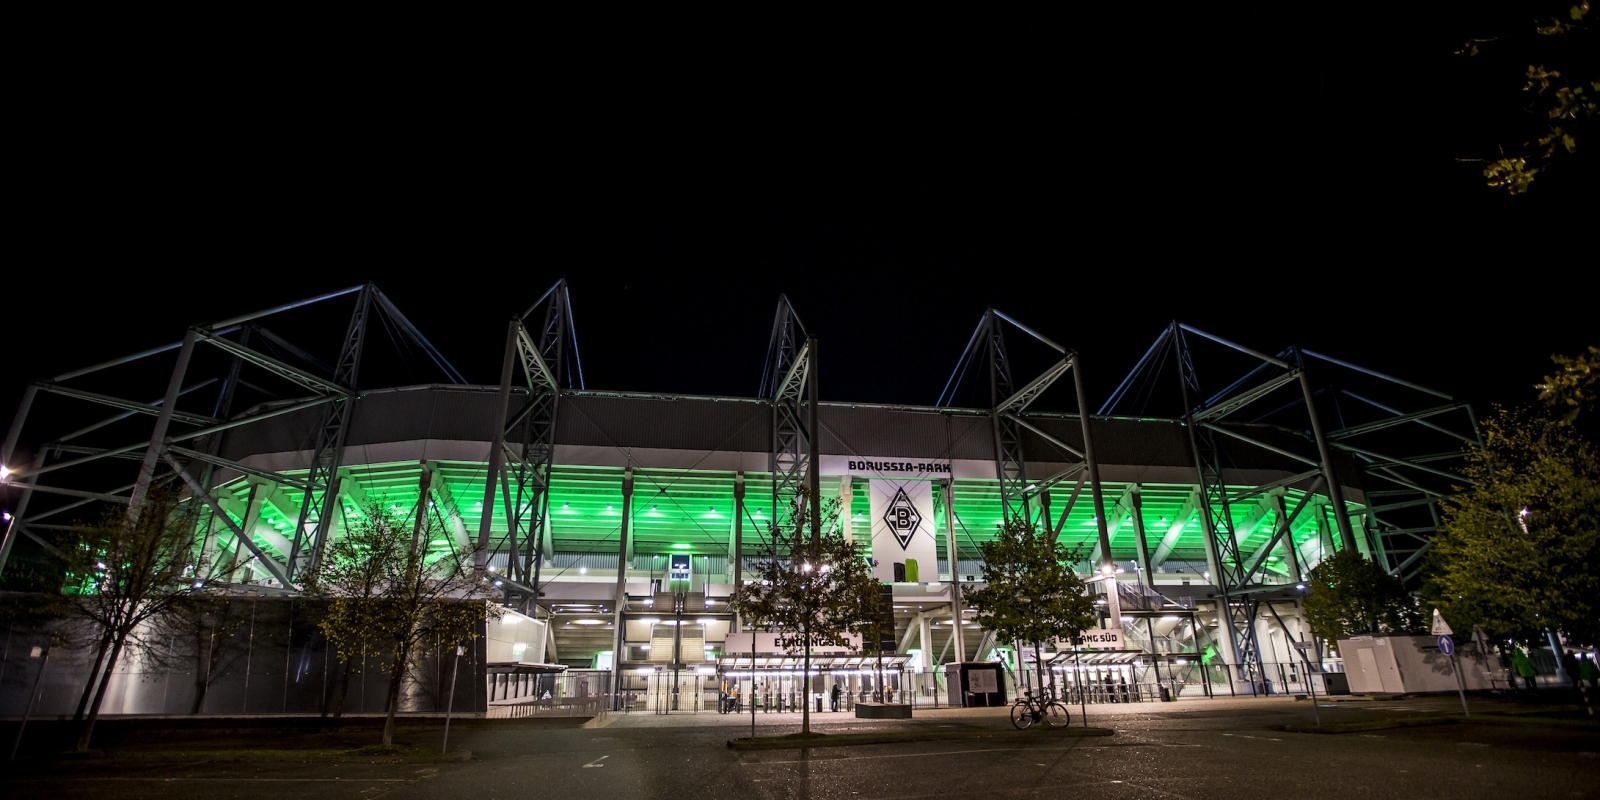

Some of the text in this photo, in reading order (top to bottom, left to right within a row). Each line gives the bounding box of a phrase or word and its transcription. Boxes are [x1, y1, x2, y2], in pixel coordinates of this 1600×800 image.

[849, 461, 951, 473] BORUSSIA-PARK
[896, 507, 911, 529] B
[774, 638, 827, 647] EIGNG
[1059, 633, 1117, 643] EIANG SÜD
